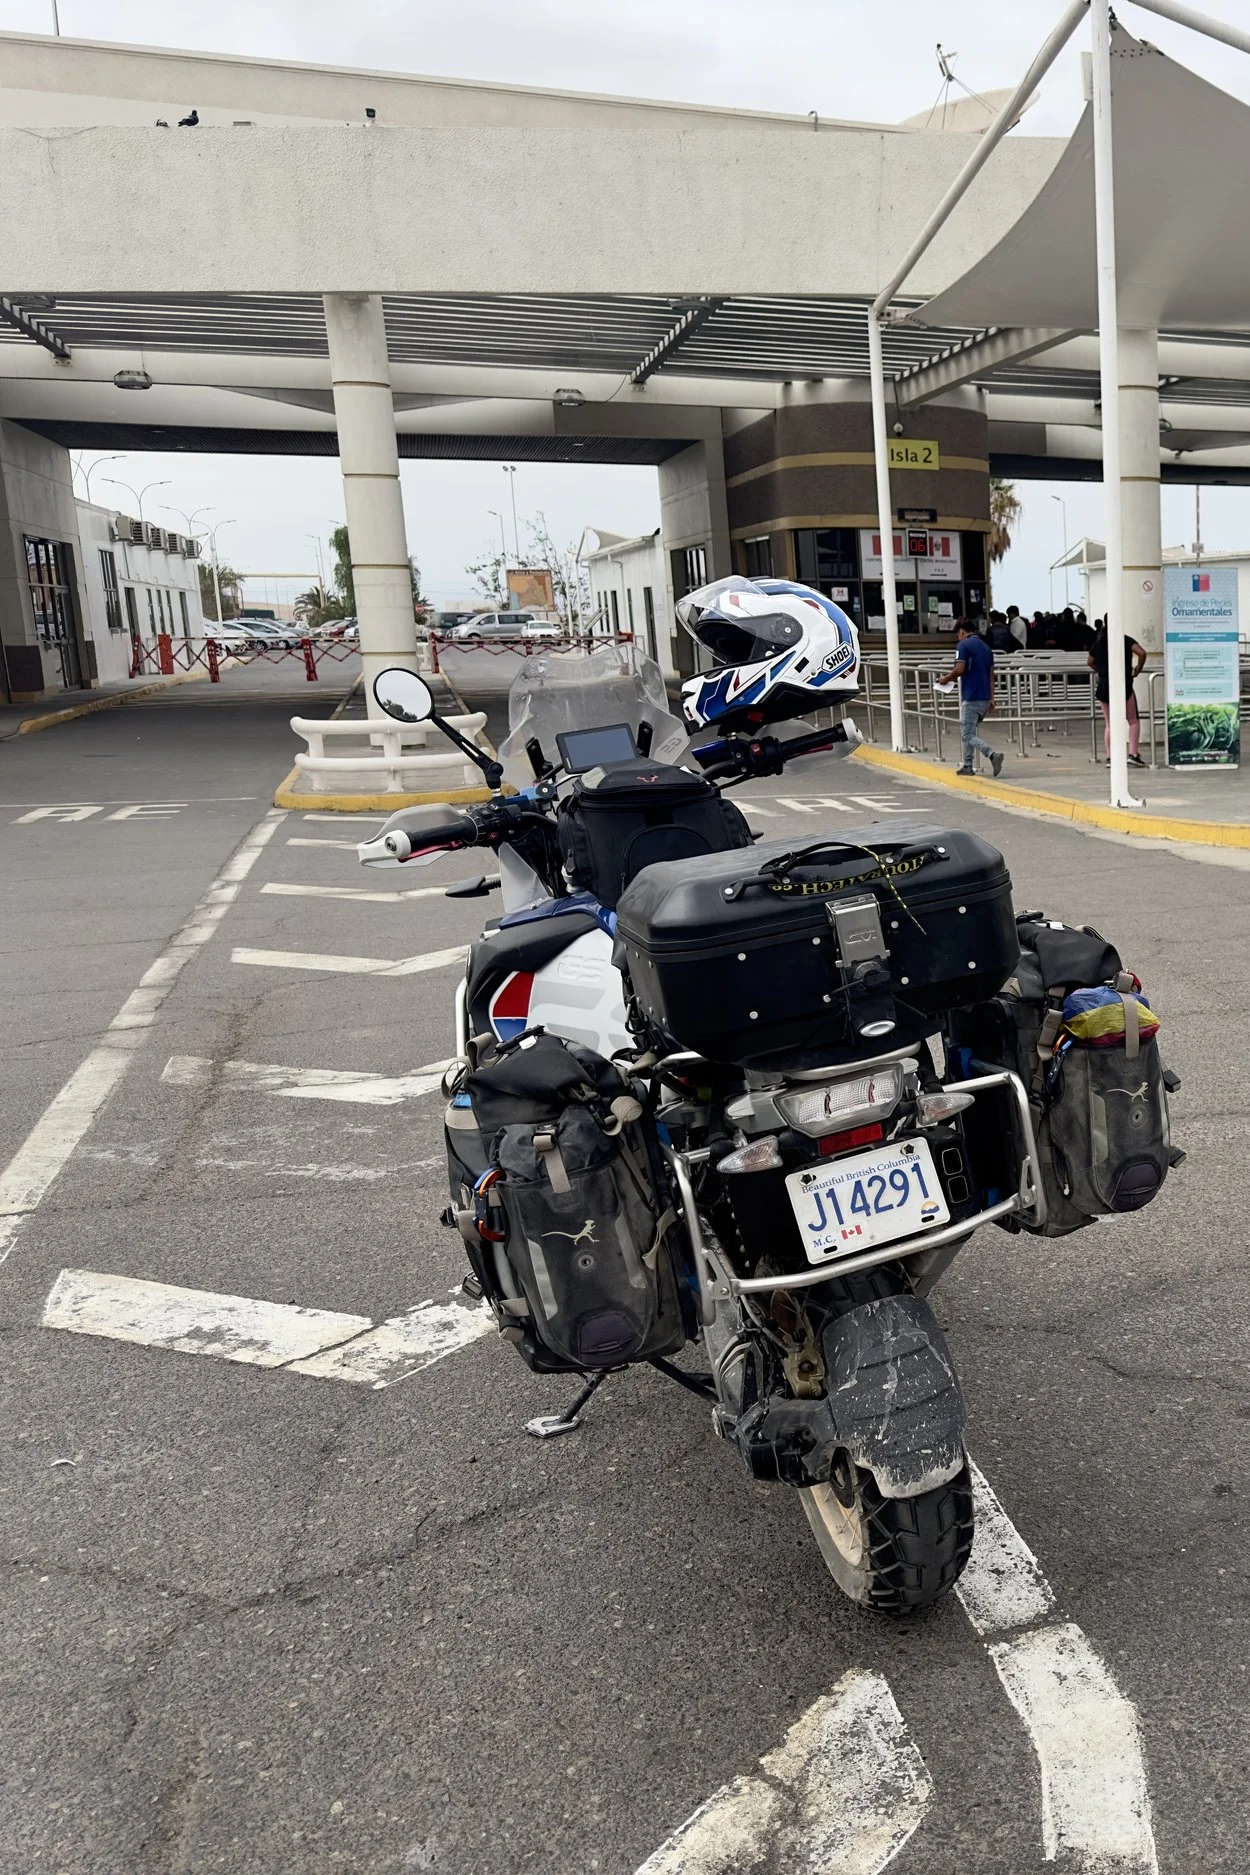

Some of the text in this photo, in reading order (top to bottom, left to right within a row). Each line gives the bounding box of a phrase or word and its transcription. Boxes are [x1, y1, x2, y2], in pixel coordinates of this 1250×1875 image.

[890, 447, 933, 463] Isla 2
[910, 540, 926, 552] 06
[1171, 607, 1233, 617] Ornamentales
[825, 645, 850, 670] SHOEI
[557, 954, 606, 982] GS
[802, 1154, 921, 1194] Beautiful British Columbia
[812, 1235, 836, 1248] M.C.
